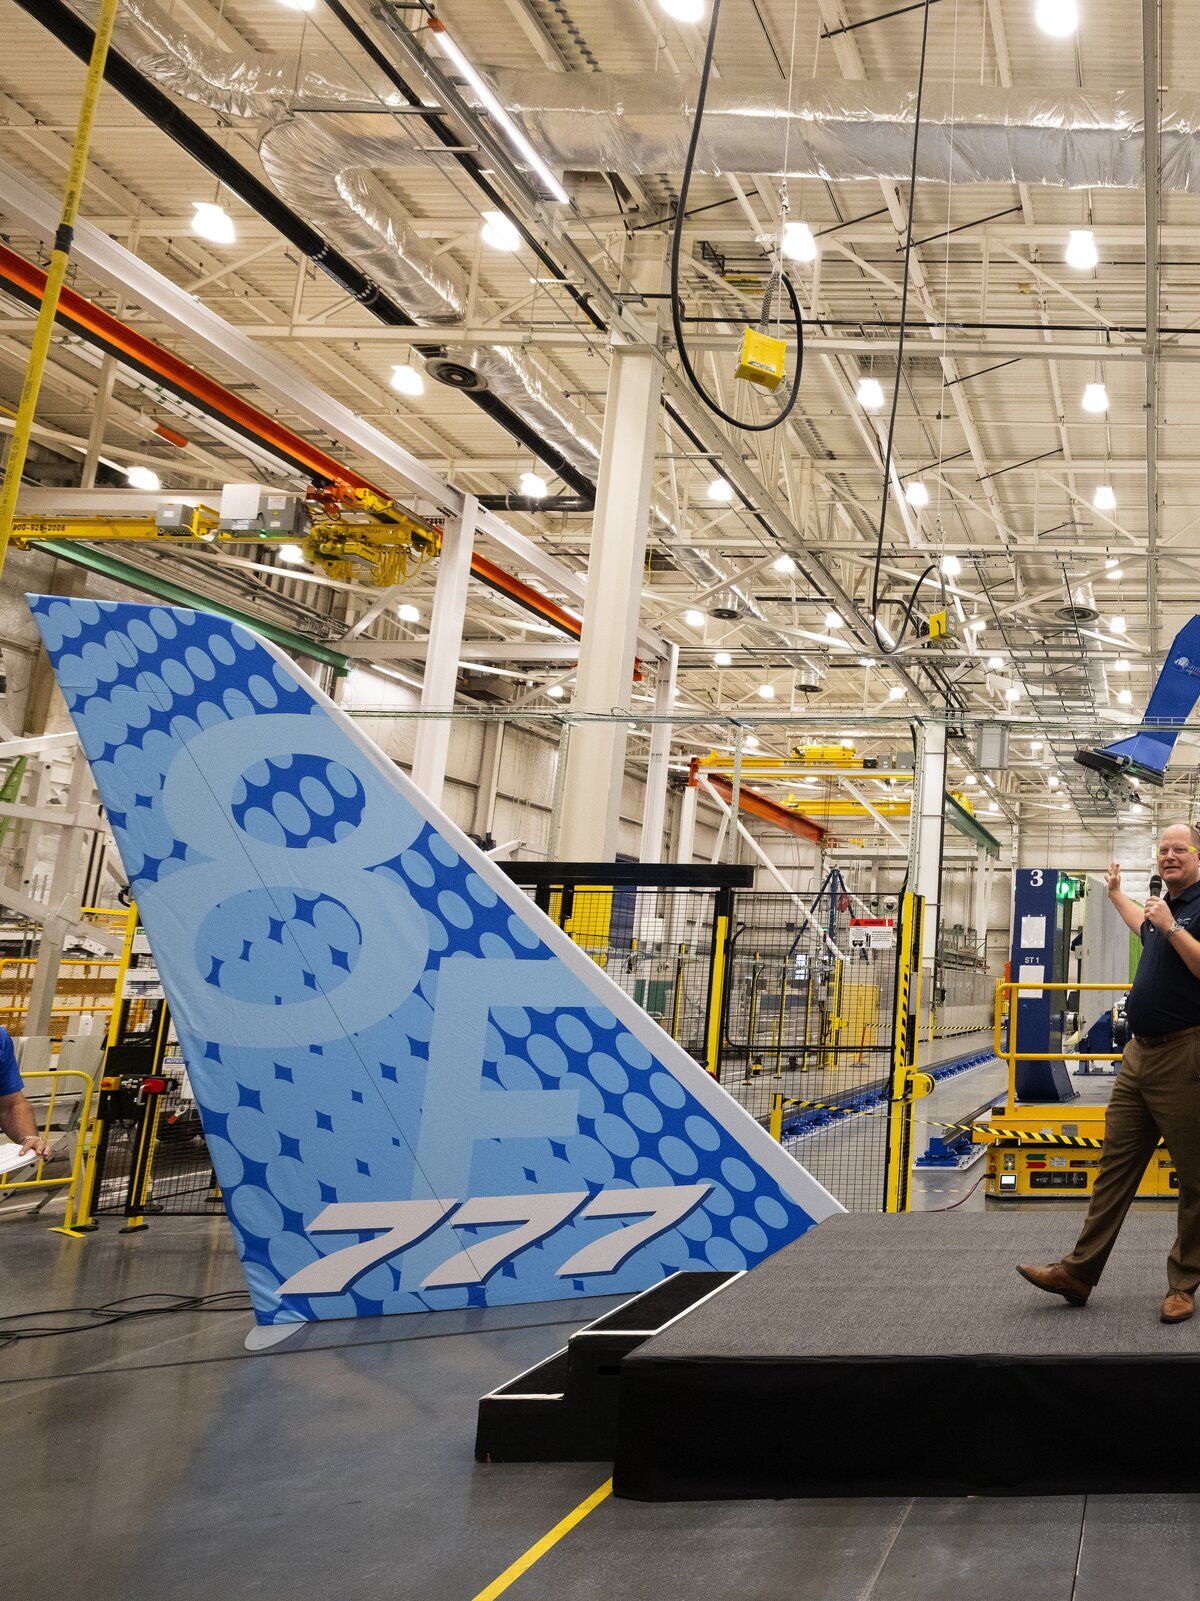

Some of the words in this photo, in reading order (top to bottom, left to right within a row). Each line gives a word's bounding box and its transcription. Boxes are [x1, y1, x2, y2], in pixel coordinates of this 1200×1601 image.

[132, 712, 430, 1048] 8
[1030, 869, 1044, 887] 3
[1024, 956, 1034, 964] ST
[1035, 956, 1040, 964] 1
[400, 956, 605, 1292] F
[275, 1183, 717, 1298] 777
